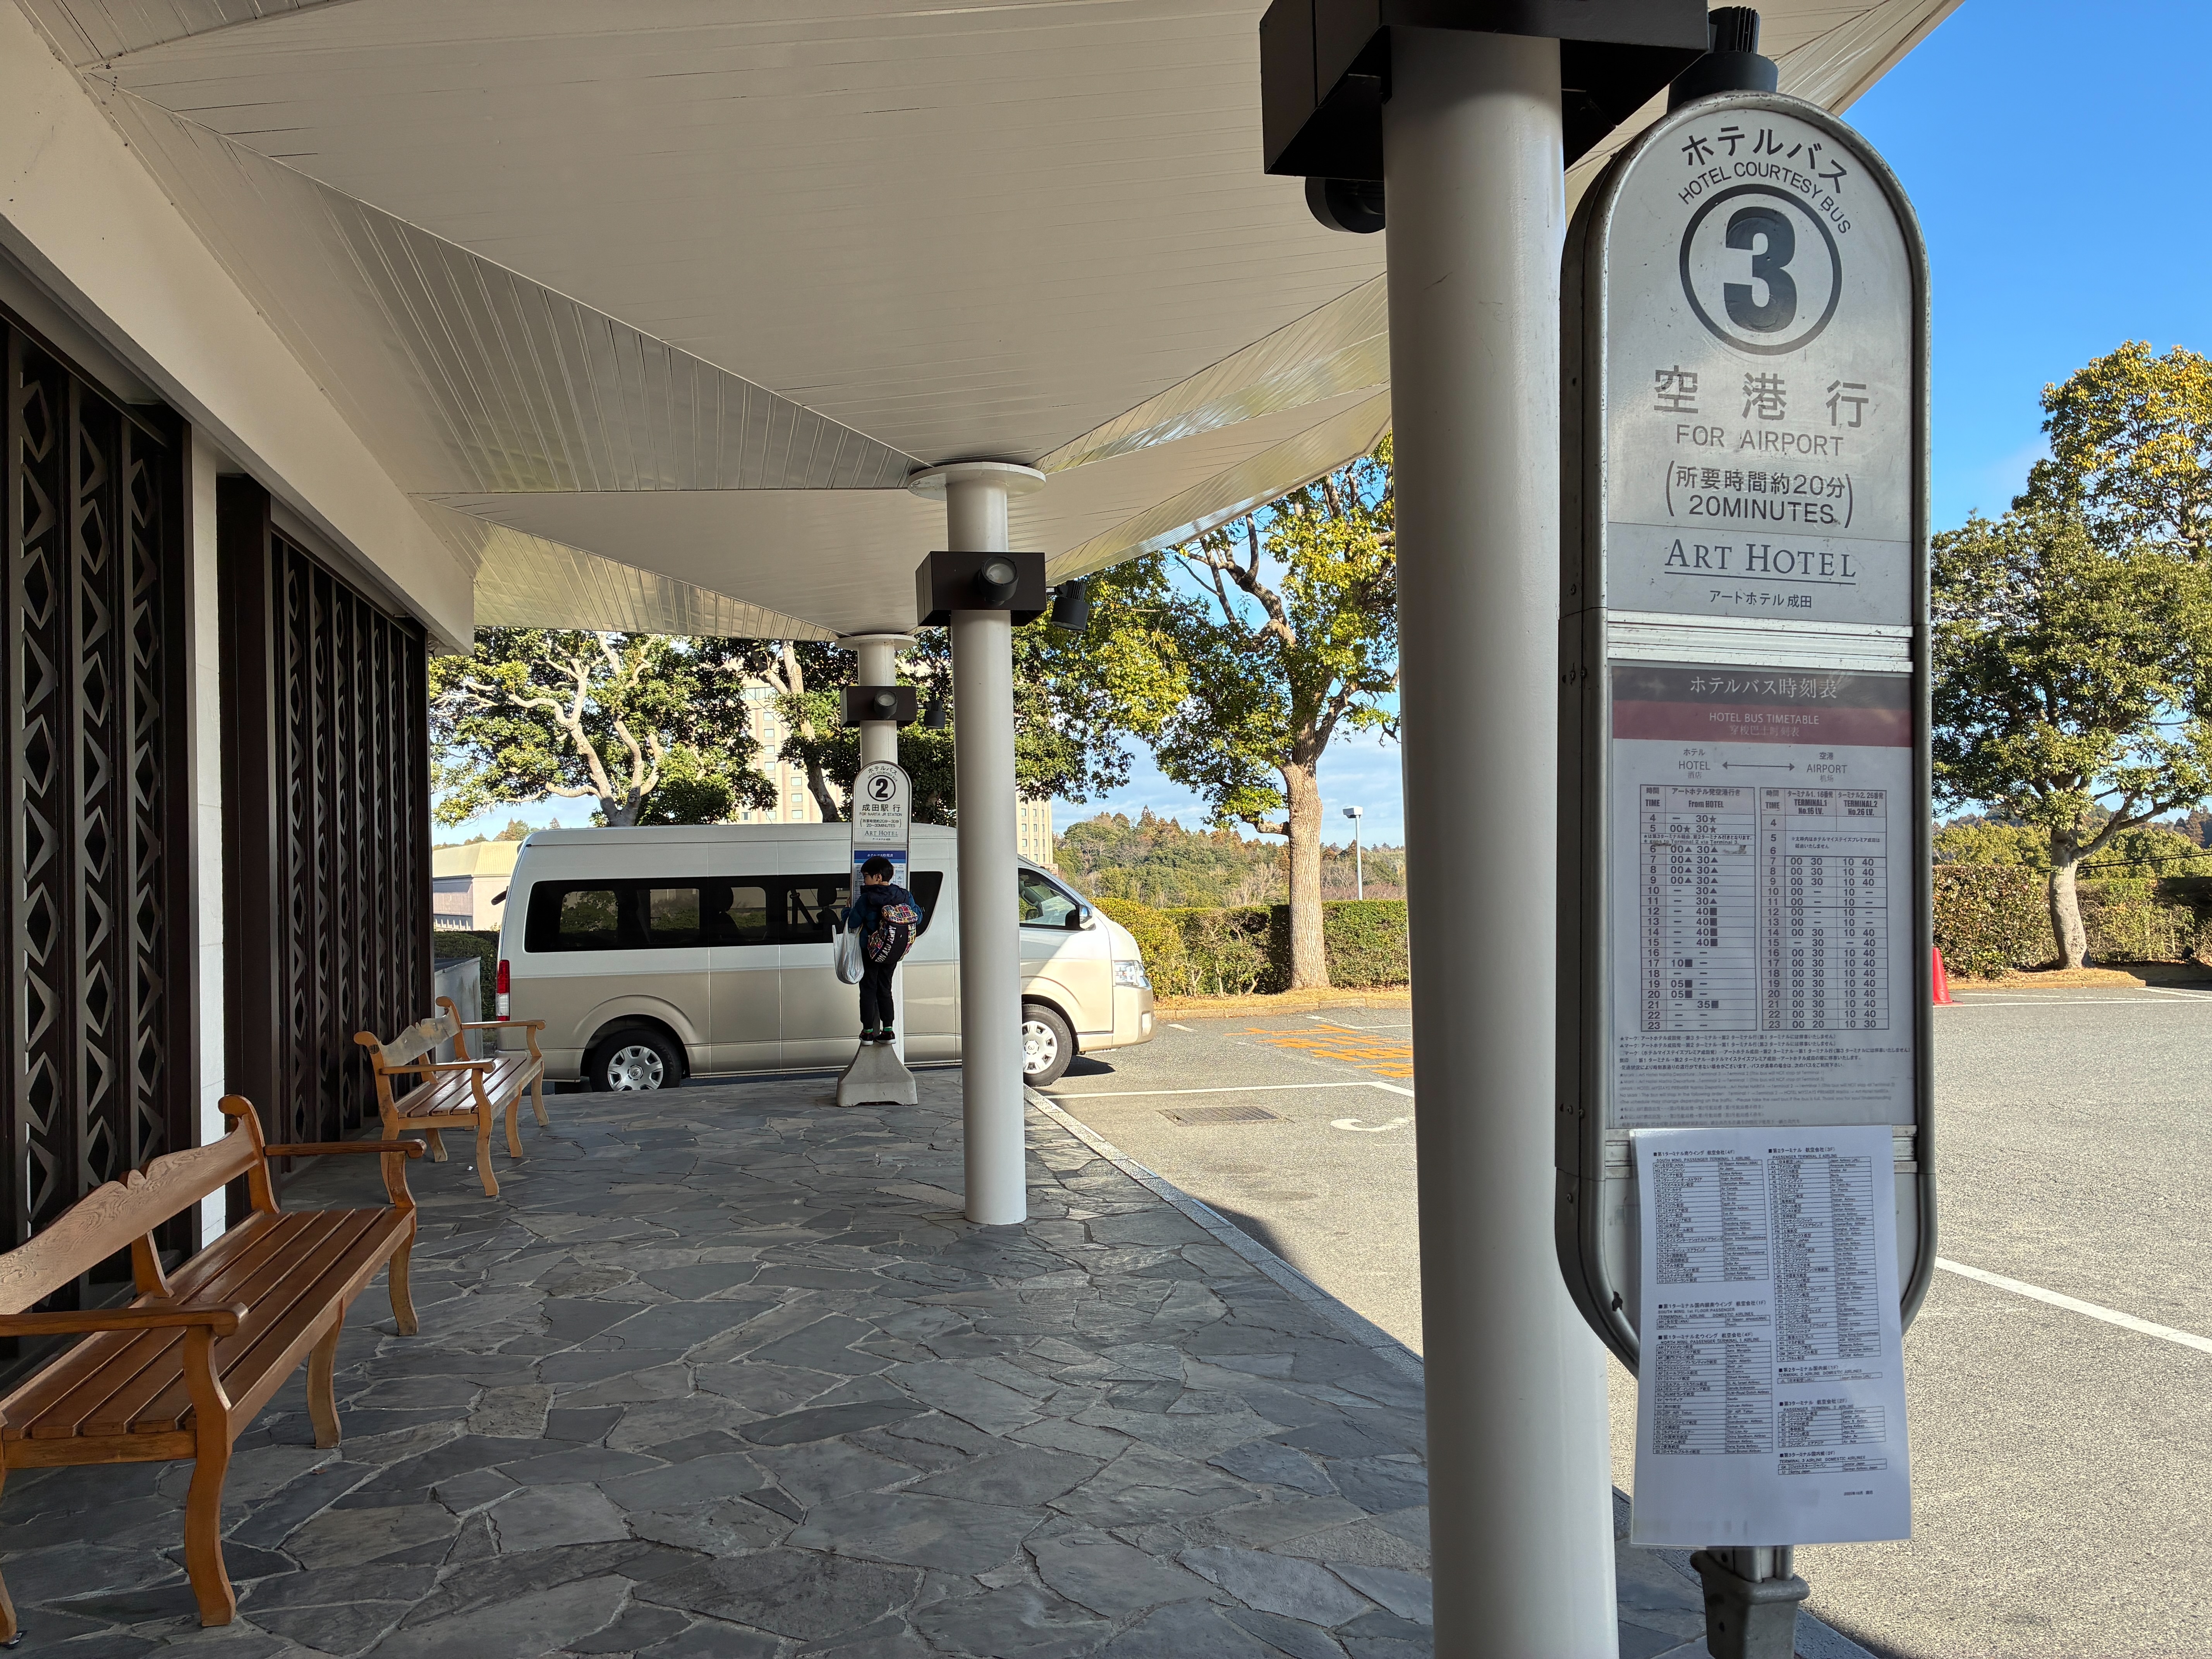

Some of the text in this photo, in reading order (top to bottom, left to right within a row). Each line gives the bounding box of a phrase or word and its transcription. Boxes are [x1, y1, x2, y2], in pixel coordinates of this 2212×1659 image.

[1682, 125, 1848, 194] ホテルバス
[1678, 161, 1851, 235] HOTEL COURTESY BUS
[1724, 207, 1798, 332] 3
[1677, 425, 1844, 456] FOR AIRPORT
[1689, 496, 1836, 524] 20MINUTES
[1665, 539, 1856, 577] ART HOTEL
[1709, 590, 1812, 608] アートホテル成田
[1691, 677, 1837, 699] ホテルバス時刻表
[1709, 713, 1819, 725] HOTEL BUS TIMETABLE
[1678, 761, 1711, 770] HOTEL
[1807, 764, 1847, 774] AIRPORT
[868, 766, 898, 775] ホテルバス
[876, 778, 888, 797] 2
[1650, 814, 1656, 822] 4
[1650, 824, 1656, 832] 5
[1650, 855, 1656, 864] 7
[1810, 857, 1822, 866] 30
[1843, 858, 1854, 866] 10
[1650, 866, 1656, 874] 8
[1650, 876, 1656, 884] 9
[1770, 877, 1776, 885] 9
[1844, 878, 1855, 886] 10
[1862, 878, 1874, 886] 40
[1648, 886, 1659, 895] 10
[1648, 896, 1658, 905] 11
[1648, 907, 1660, 915] 12
[1648, 917, 1659, 926] 13
[1648, 928, 1659, 936] 14
[1648, 938, 1659, 946] 15
[1648, 949, 1659, 957] 16
[1648, 959, 1660, 967] 17
[1648, 970, 1660, 978] 18
[1649, 980, 1660, 988] 19
[1648, 990, 1660, 998] 20
[1768, 989, 1780, 998] 20
[1812, 989, 1824, 998] 30
[1844, 989, 1856, 998] 10
[1863, 989, 1875, 998] 40
[1648, 1001, 1659, 1009] 21
[1648, 1011, 1660, 1019] 22
[1648, 1022, 1660, 1030] 23
[1769, 1020, 1780, 1029] 23
[1792, 1020, 1805, 1029] 00
[1812, 1020, 1824, 1028] 20
